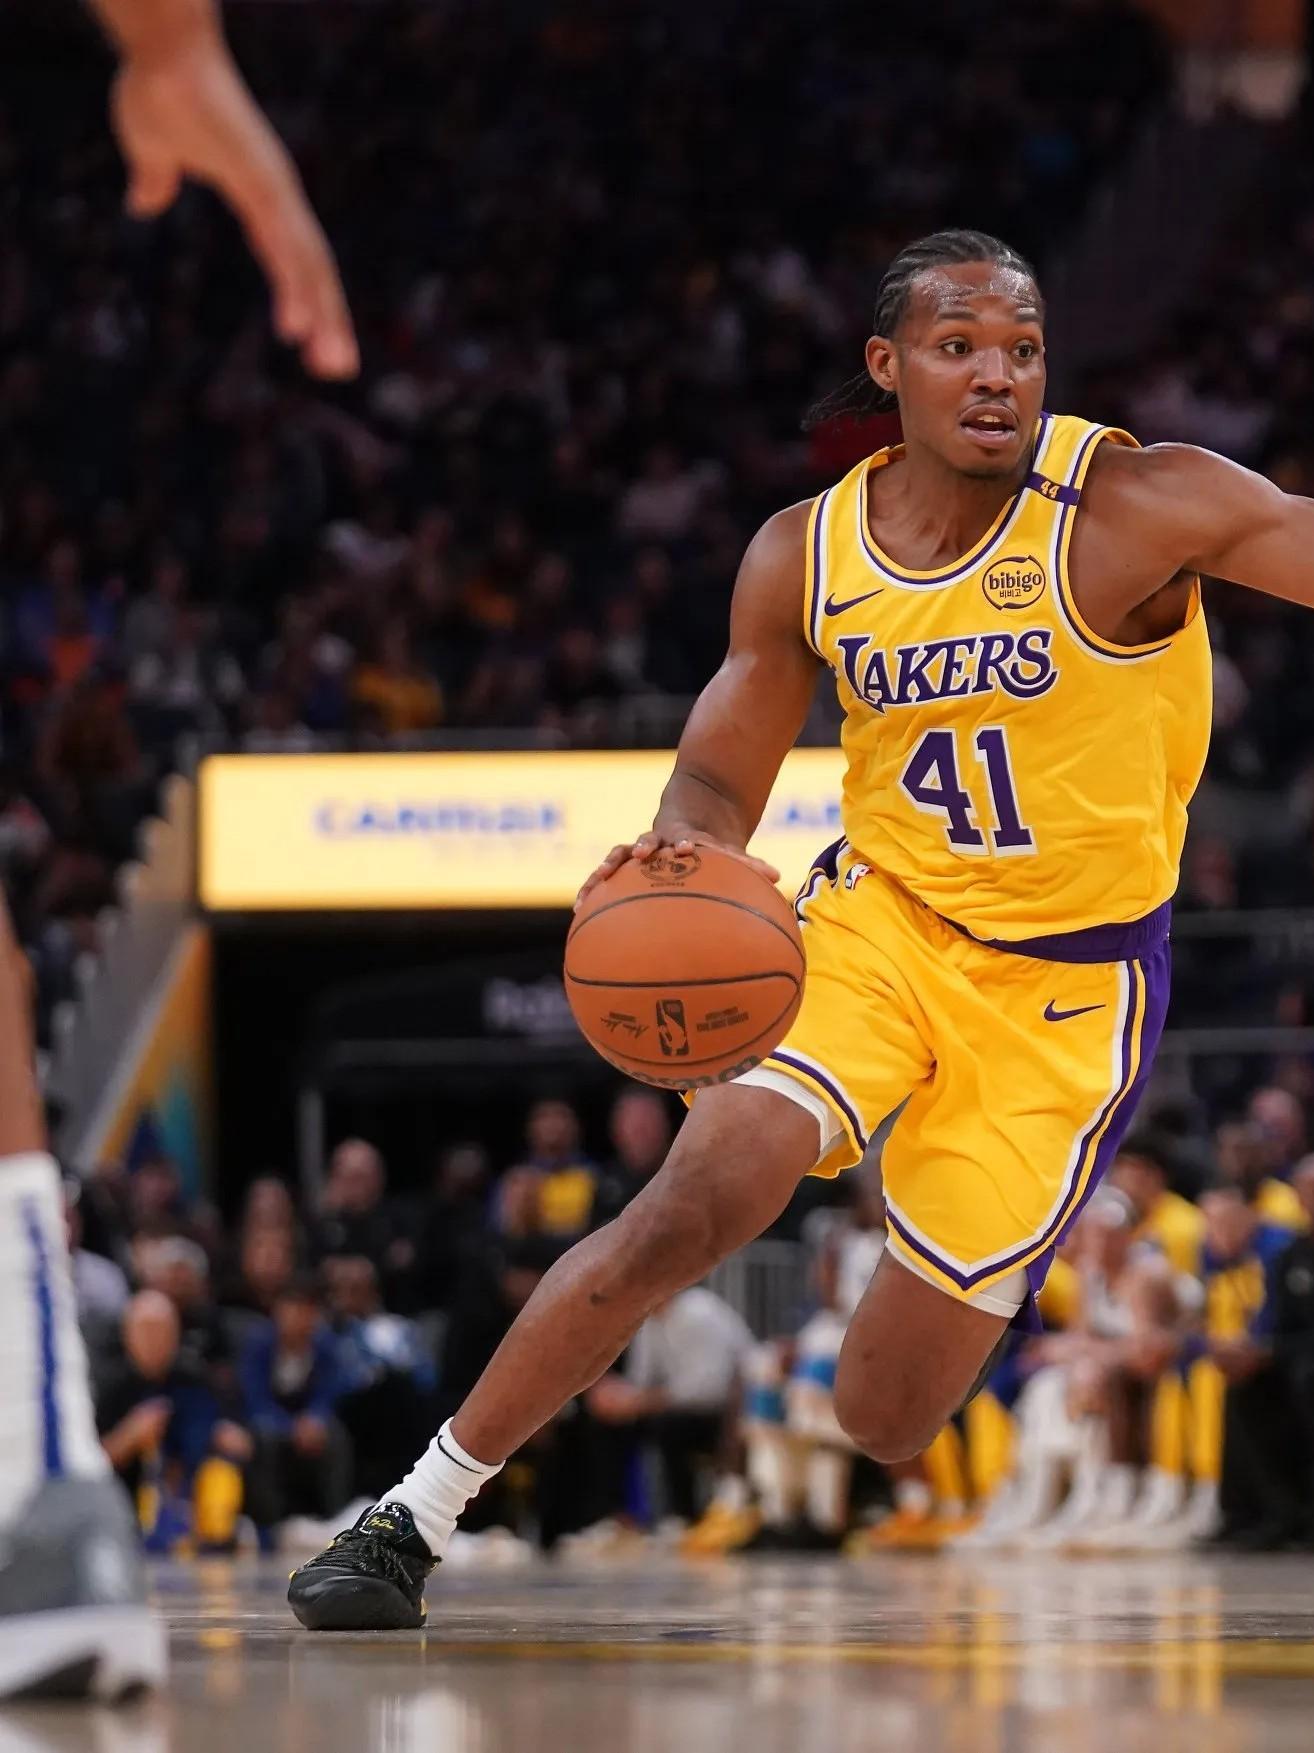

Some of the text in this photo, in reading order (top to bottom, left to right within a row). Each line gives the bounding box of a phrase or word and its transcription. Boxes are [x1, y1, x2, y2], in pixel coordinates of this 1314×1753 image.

[1040, 480, 1060, 499] 44
[988, 570, 1043, 592] bibigo
[836, 628, 1060, 714] LAKERS
[899, 725, 1039, 858] 41
